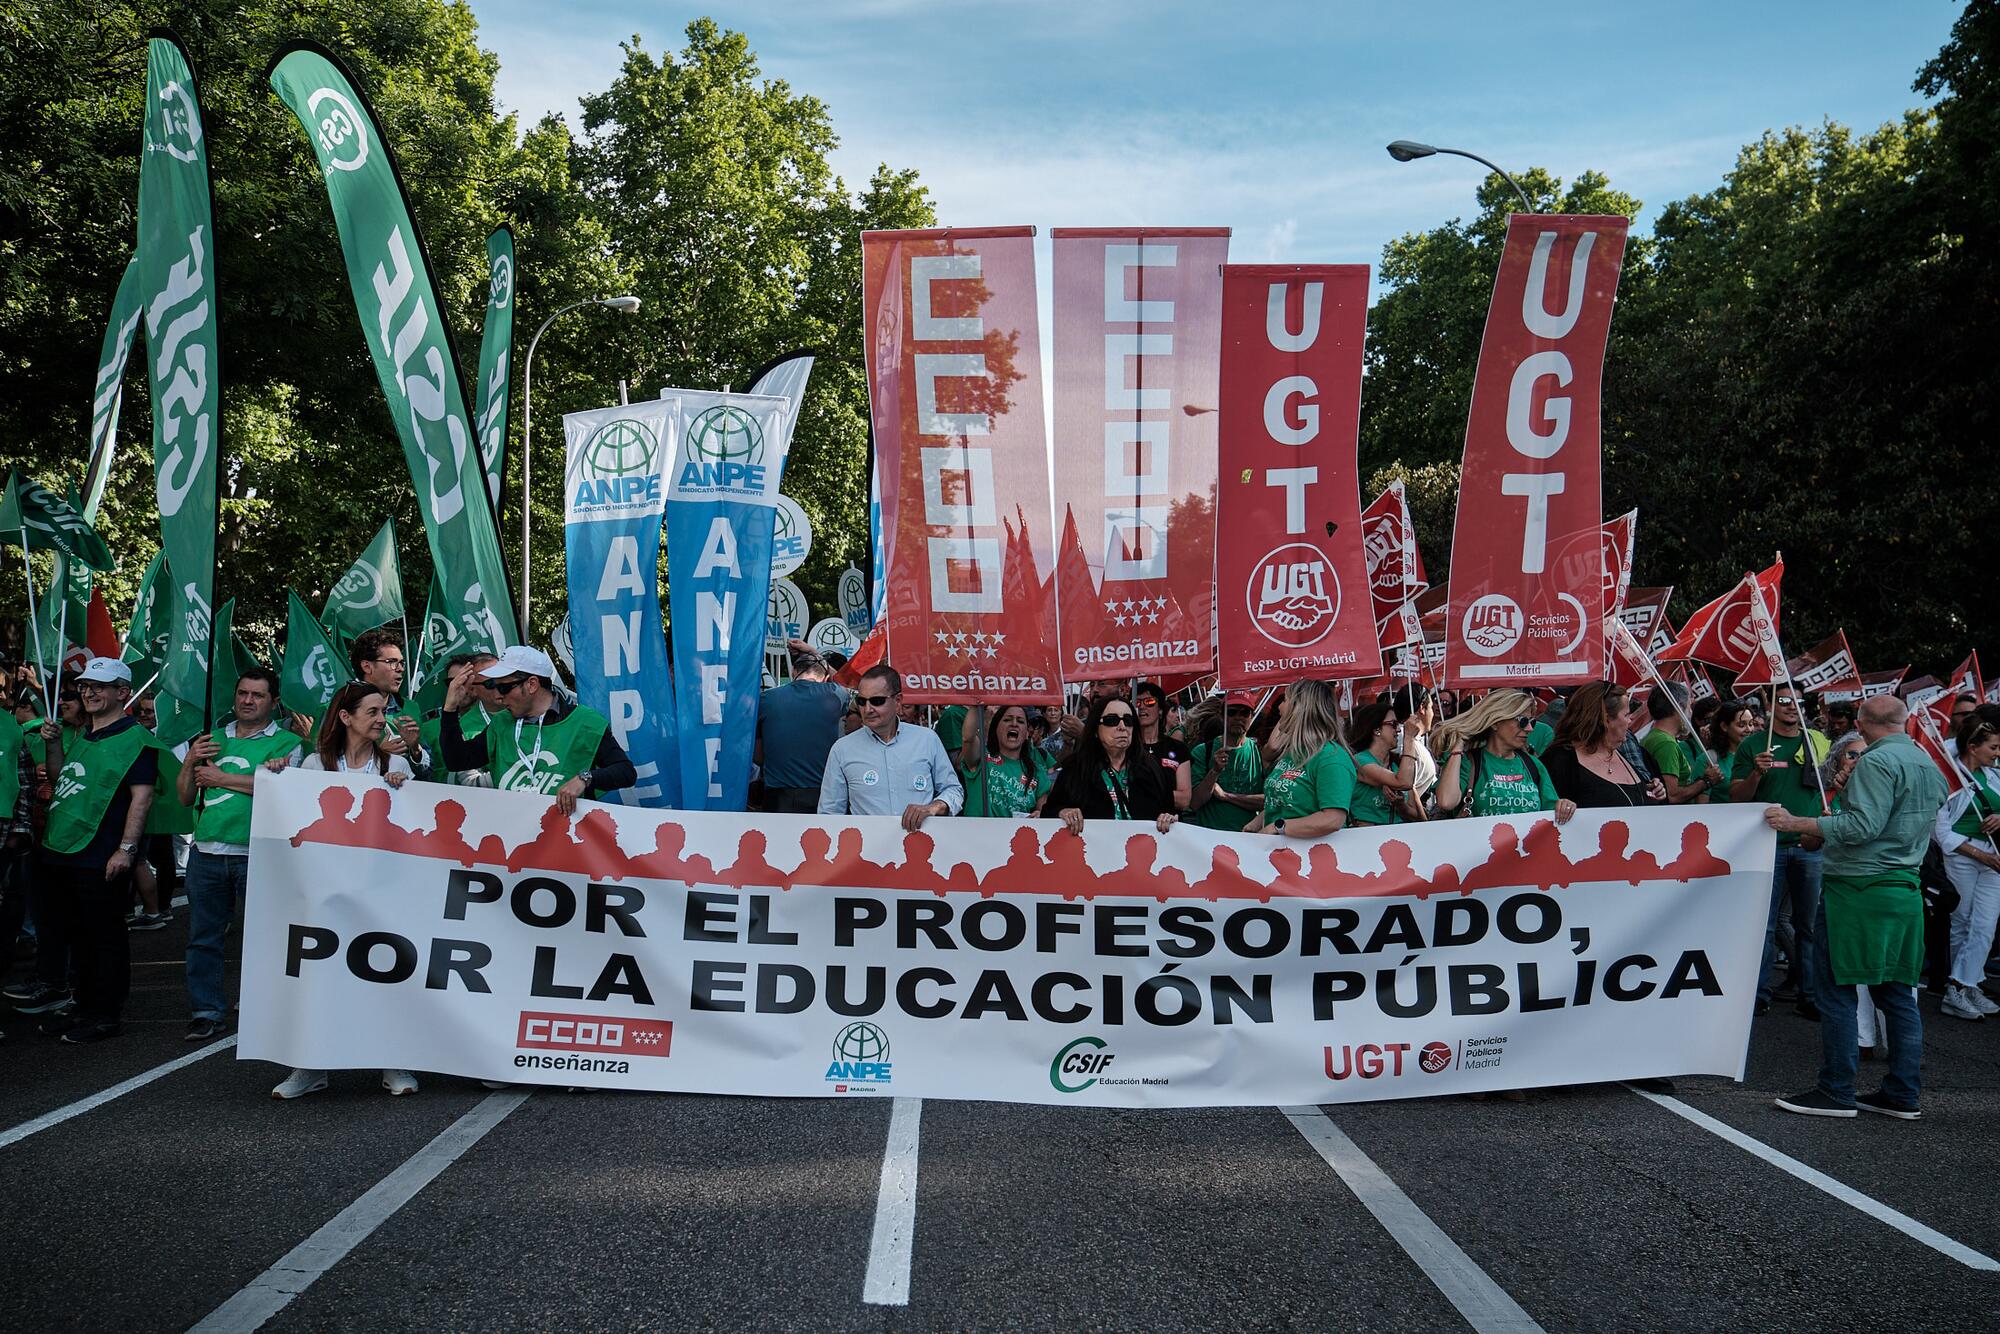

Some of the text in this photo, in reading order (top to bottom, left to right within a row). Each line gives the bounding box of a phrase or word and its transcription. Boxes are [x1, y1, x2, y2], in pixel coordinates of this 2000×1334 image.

[1105, 244, 1178, 581] CCOO
[1263, 282, 1325, 534] UGT
[1501, 231, 1597, 574] UGT
[911, 255, 1004, 613] CCOO
[679, 461, 767, 491] ANPE
[574, 473, 661, 507] ANPE
[678, 486, 715, 494] SINDICATO
[1261, 561, 1325, 604] UGT
[847, 607, 869, 625] ANP
[1469, 605, 1516, 631] UGT
[1529, 613, 1570, 626] Servicios
[1527, 627, 1568, 639] Públicos
[692, 517, 742, 798] ANPE
[1074, 638, 1199, 664] enseñanza
[1244, 651, 1357, 673] FeSP-UGT-Madrid
[905, 669, 1048, 691] enseñanza
[1506, 664, 1541, 676] Madrid
[443, 868, 1591, 959] POR EL PROFESORADO,
[285, 923, 1724, 1027] POR LA EDUCACIÓN PÚBLICA
[525, 1019, 624, 1047] CCOO
[1467, 1036, 1508, 1047] Servicios
[514, 1054, 629, 1074] enseñanza
[1063, 1053, 1116, 1074] CSIF
[1324, 1043, 1411, 1080] UGT
[1464, 1057, 1501, 1070] Madrid
[1466, 1046, 1503, 1058] Públicos
[825, 1061, 892, 1080] ANPE
